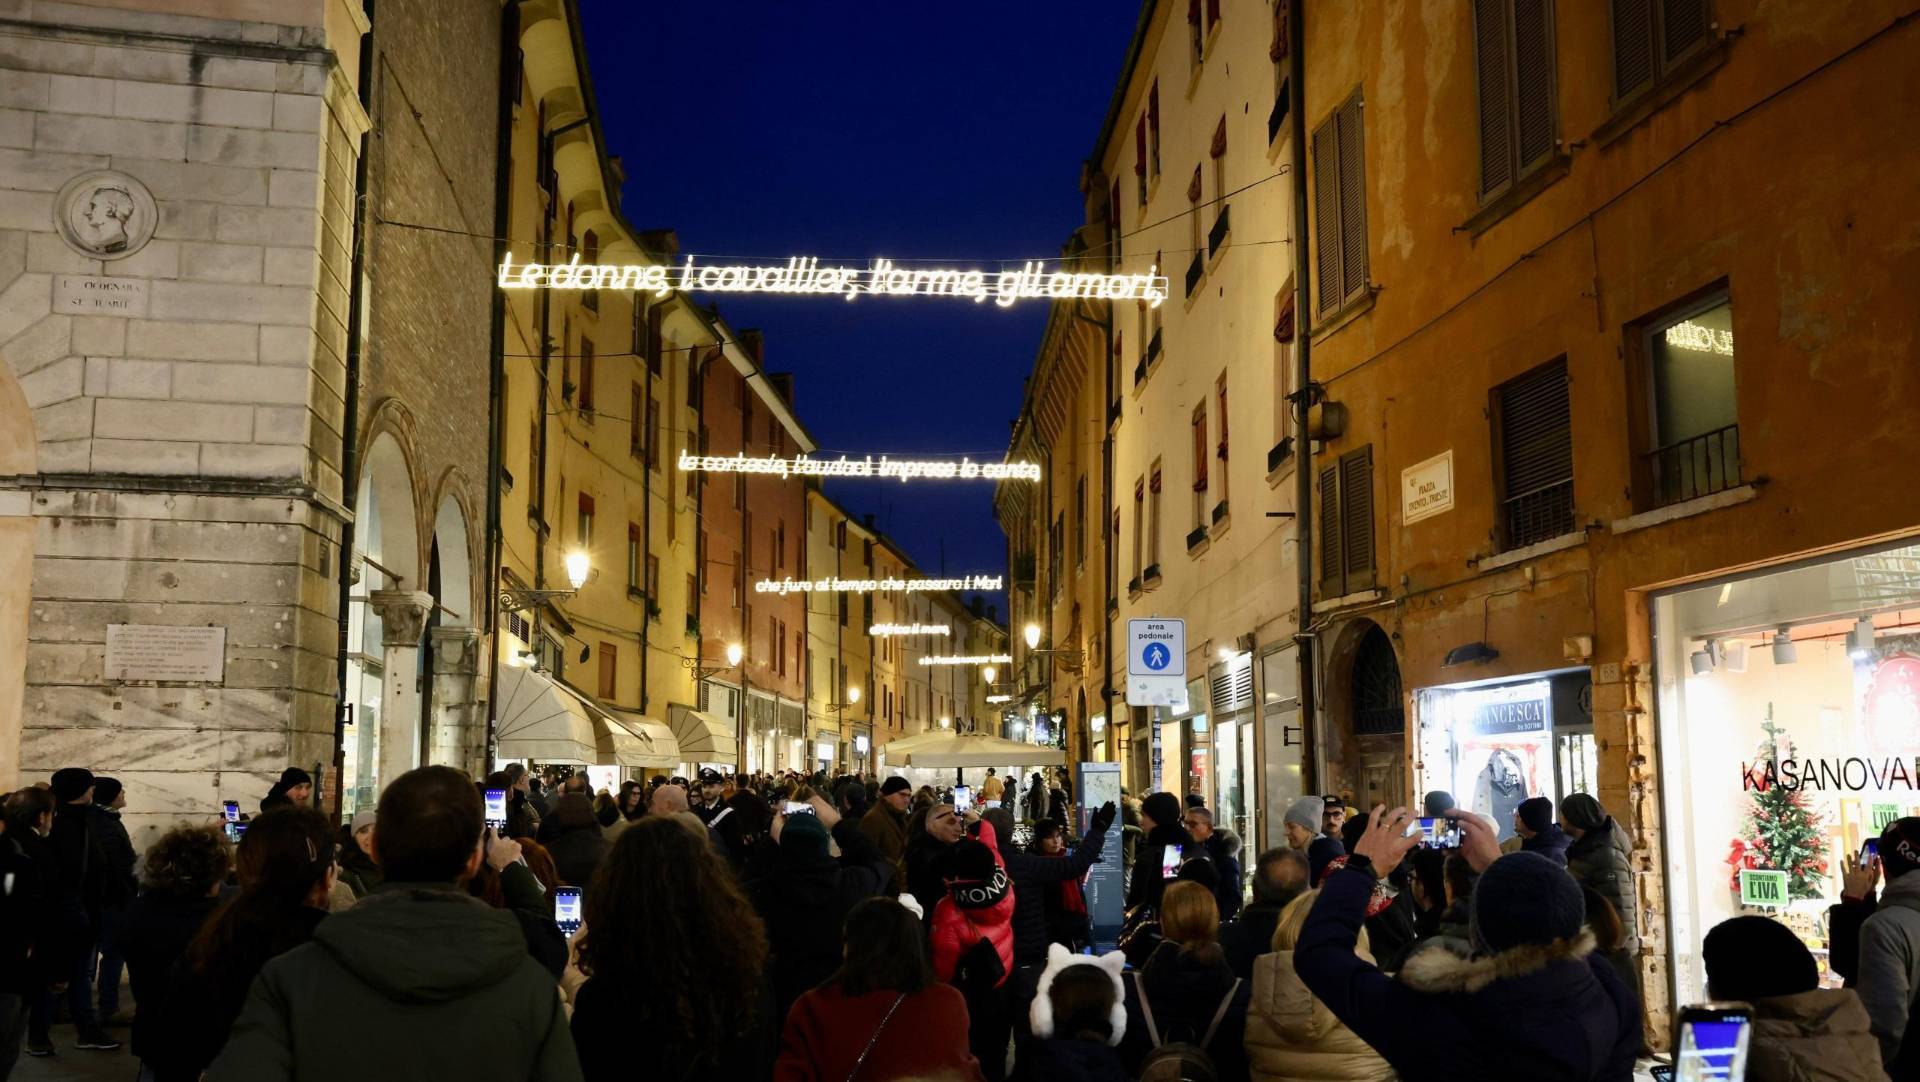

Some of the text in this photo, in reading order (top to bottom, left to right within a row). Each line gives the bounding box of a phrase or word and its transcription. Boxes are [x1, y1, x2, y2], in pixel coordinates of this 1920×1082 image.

[500, 251, 545, 288] Le
[551, 253, 669, 297] donne,
[996, 261, 1043, 307] gli
[1050, 265, 1163, 308] amori,
[755, 578, 780, 592] che
[779, 576, 812, 596] furo
[832, 576, 877, 595] tempo
[880, 575, 905, 591] che
[906, 579, 962, 595] passaro
[1742, 757, 1912, 792] KASANOVA
[1749, 873, 1778, 882] SCONTIAMO
[1750, 881, 1779, 900] L'IVA
